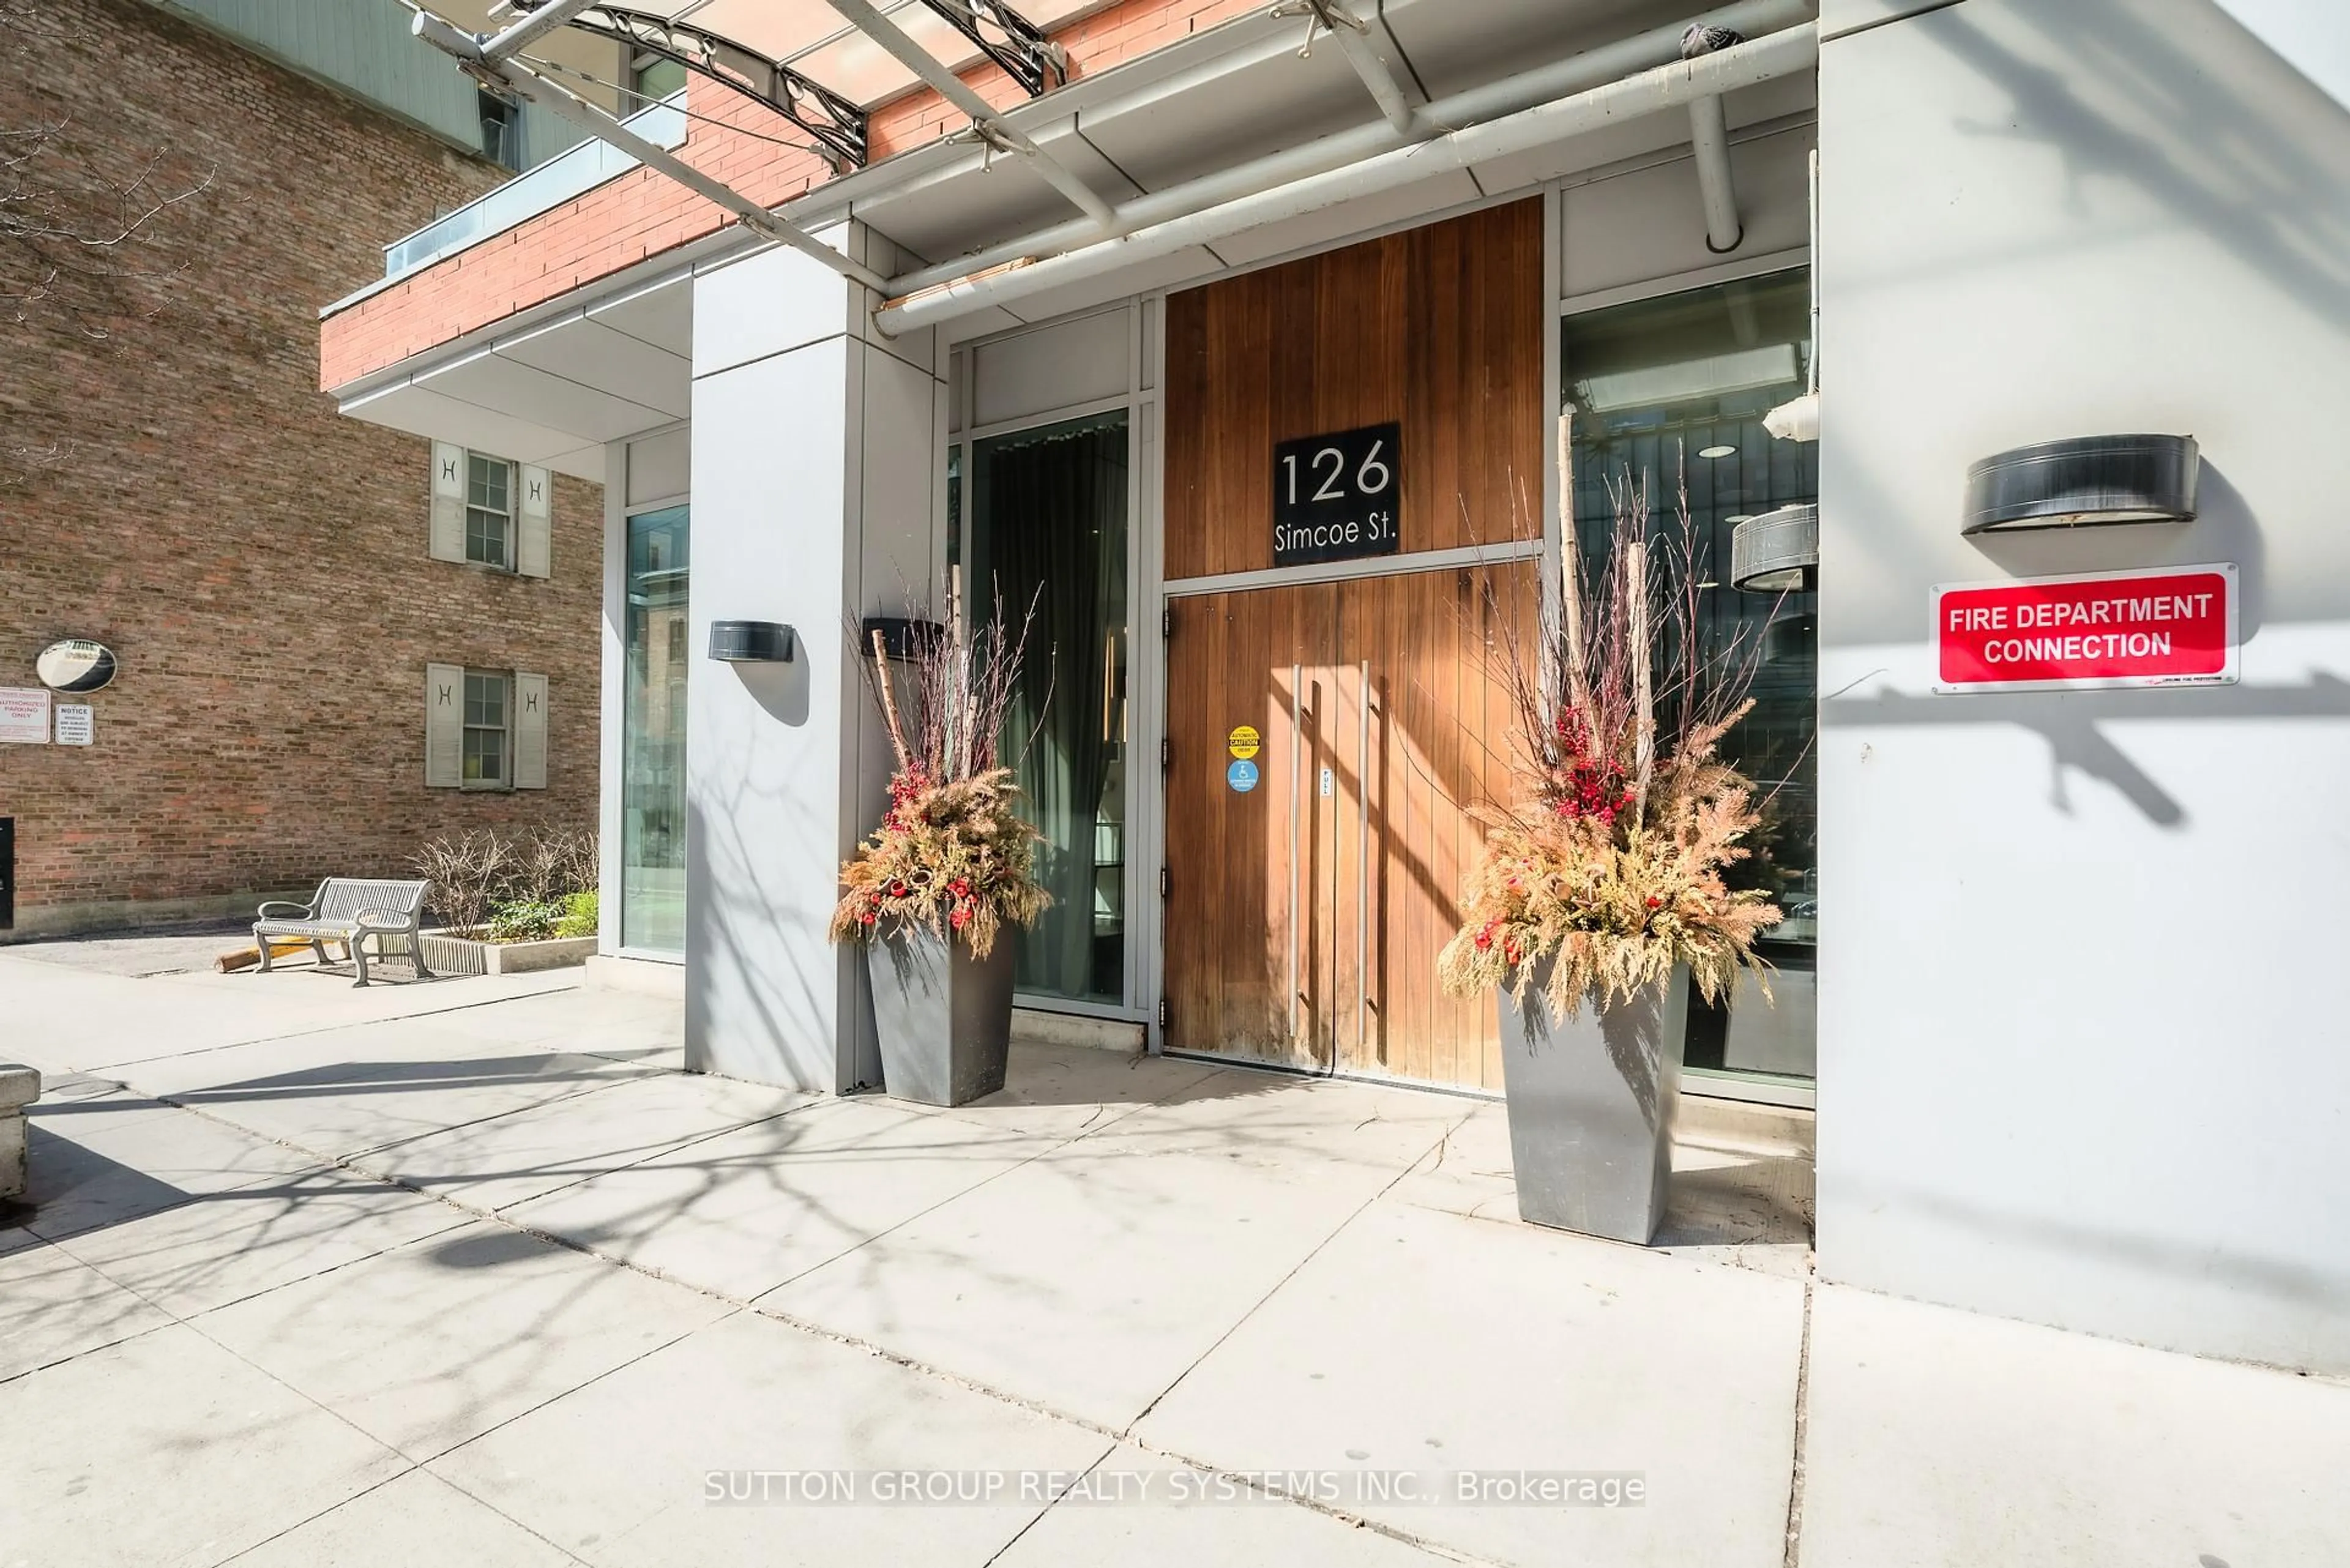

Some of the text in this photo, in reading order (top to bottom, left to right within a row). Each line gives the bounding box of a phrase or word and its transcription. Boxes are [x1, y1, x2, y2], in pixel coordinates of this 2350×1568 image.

[1283, 440, 1389, 504] 126
[1275, 511, 1396, 551] Simcoe St.
[1950, 594, 2213, 632] FIRE DEPARTMENT
[1985, 632, 2171, 663] CONNECTION
